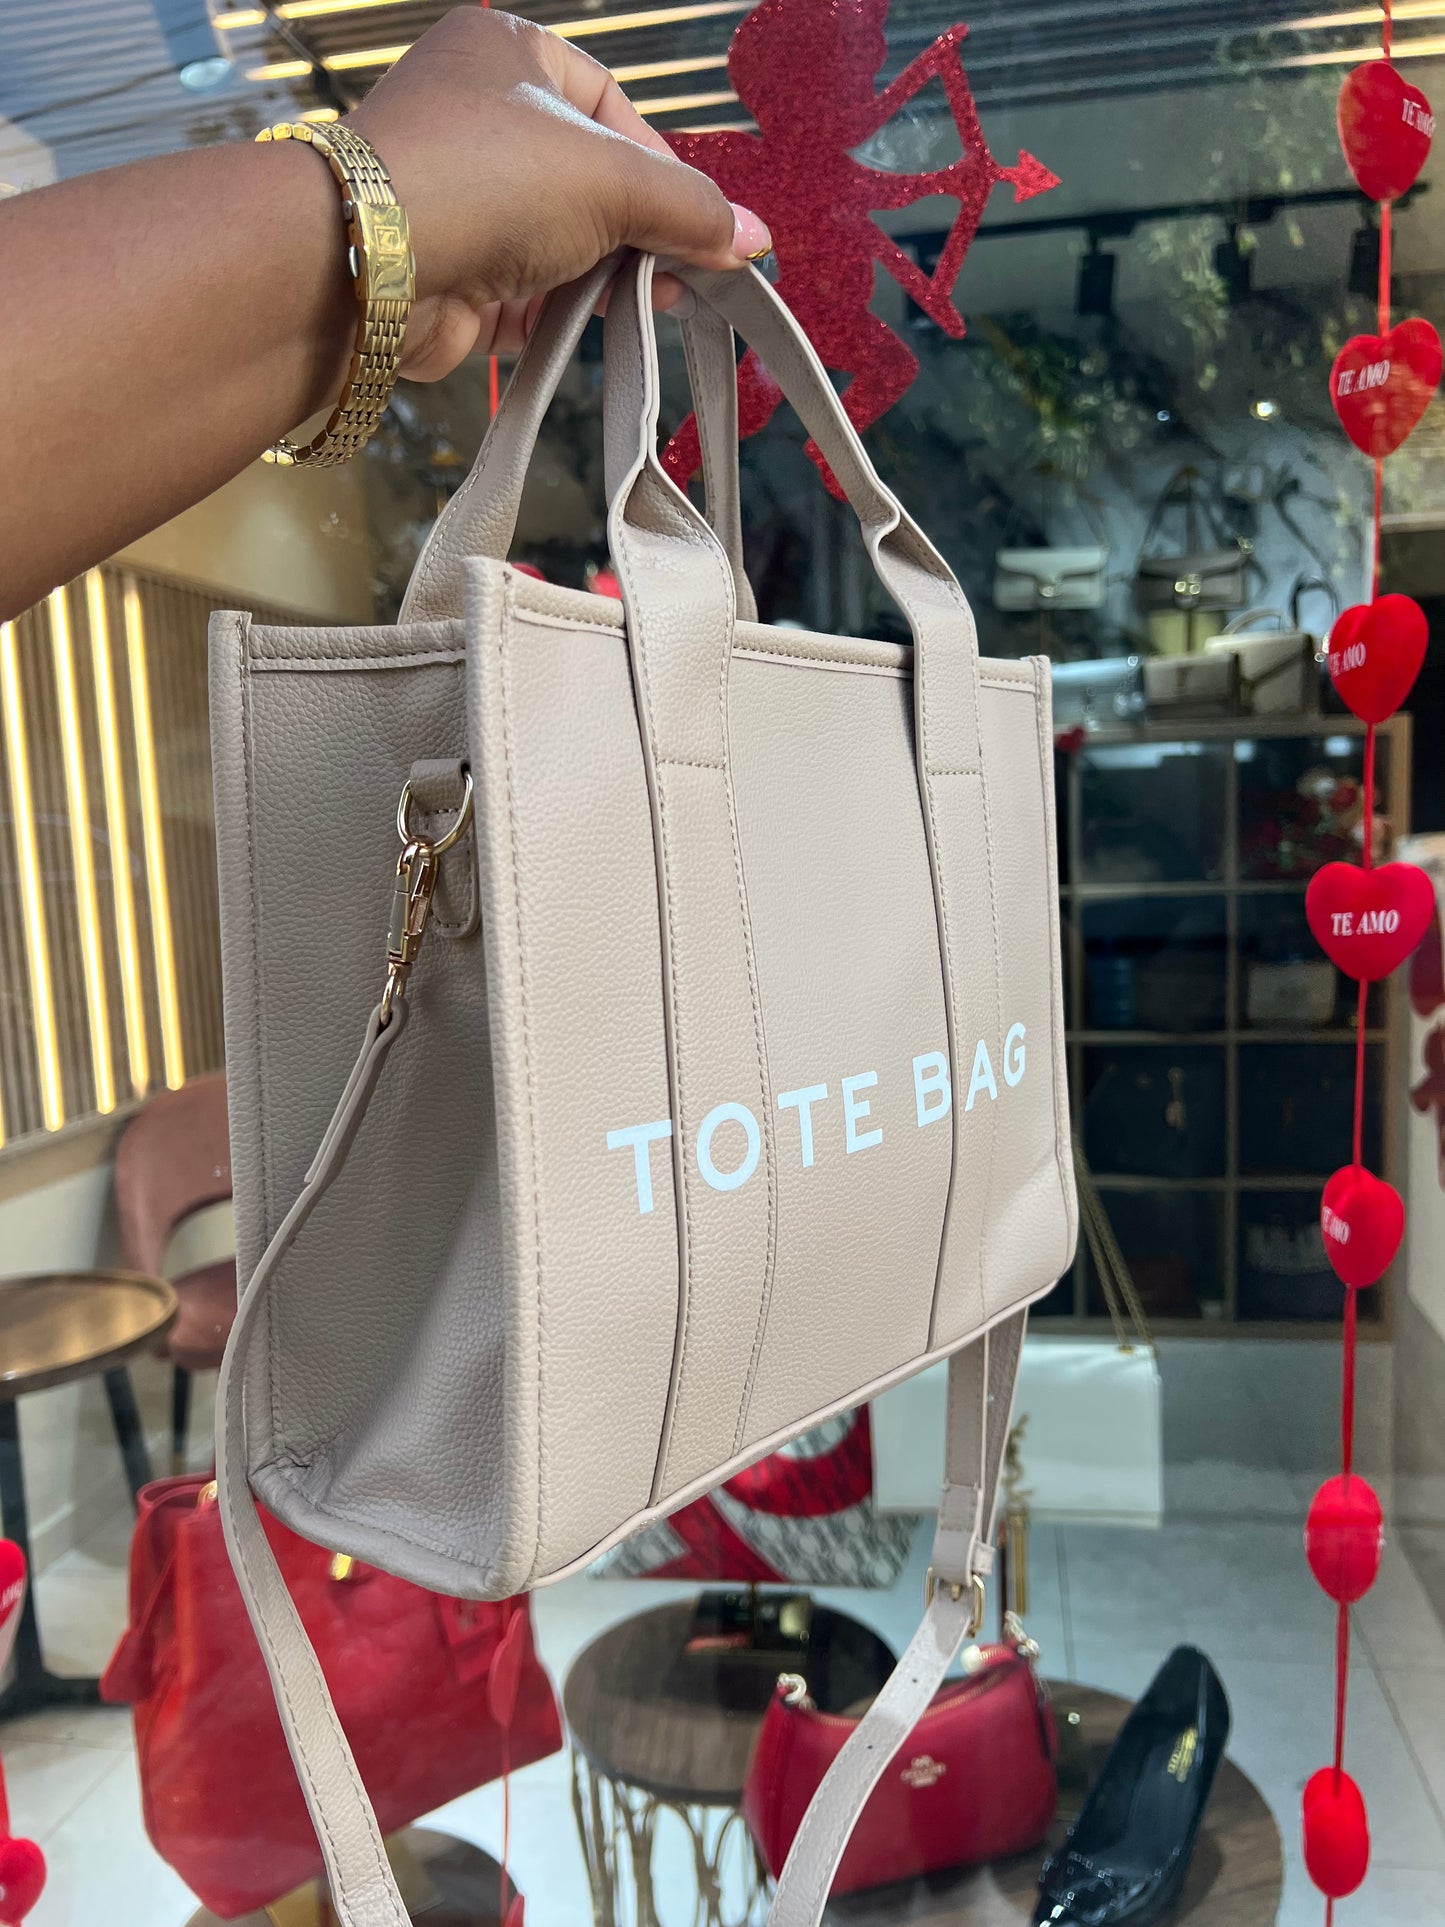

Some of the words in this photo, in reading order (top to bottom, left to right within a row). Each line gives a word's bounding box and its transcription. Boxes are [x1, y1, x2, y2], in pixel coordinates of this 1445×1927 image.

[1402, 97, 1421, 126] TE
[1338, 369, 1356, 396] TE
[1353, 359, 1390, 392] AMO
[1340, 641, 1366, 671] AMO
[1331, 911, 1354, 936] TE
[1356, 909, 1399, 935] AMO
[606, 1071, 883, 1214] TOTE
[912, 1022, 1027, 1128] BAG
